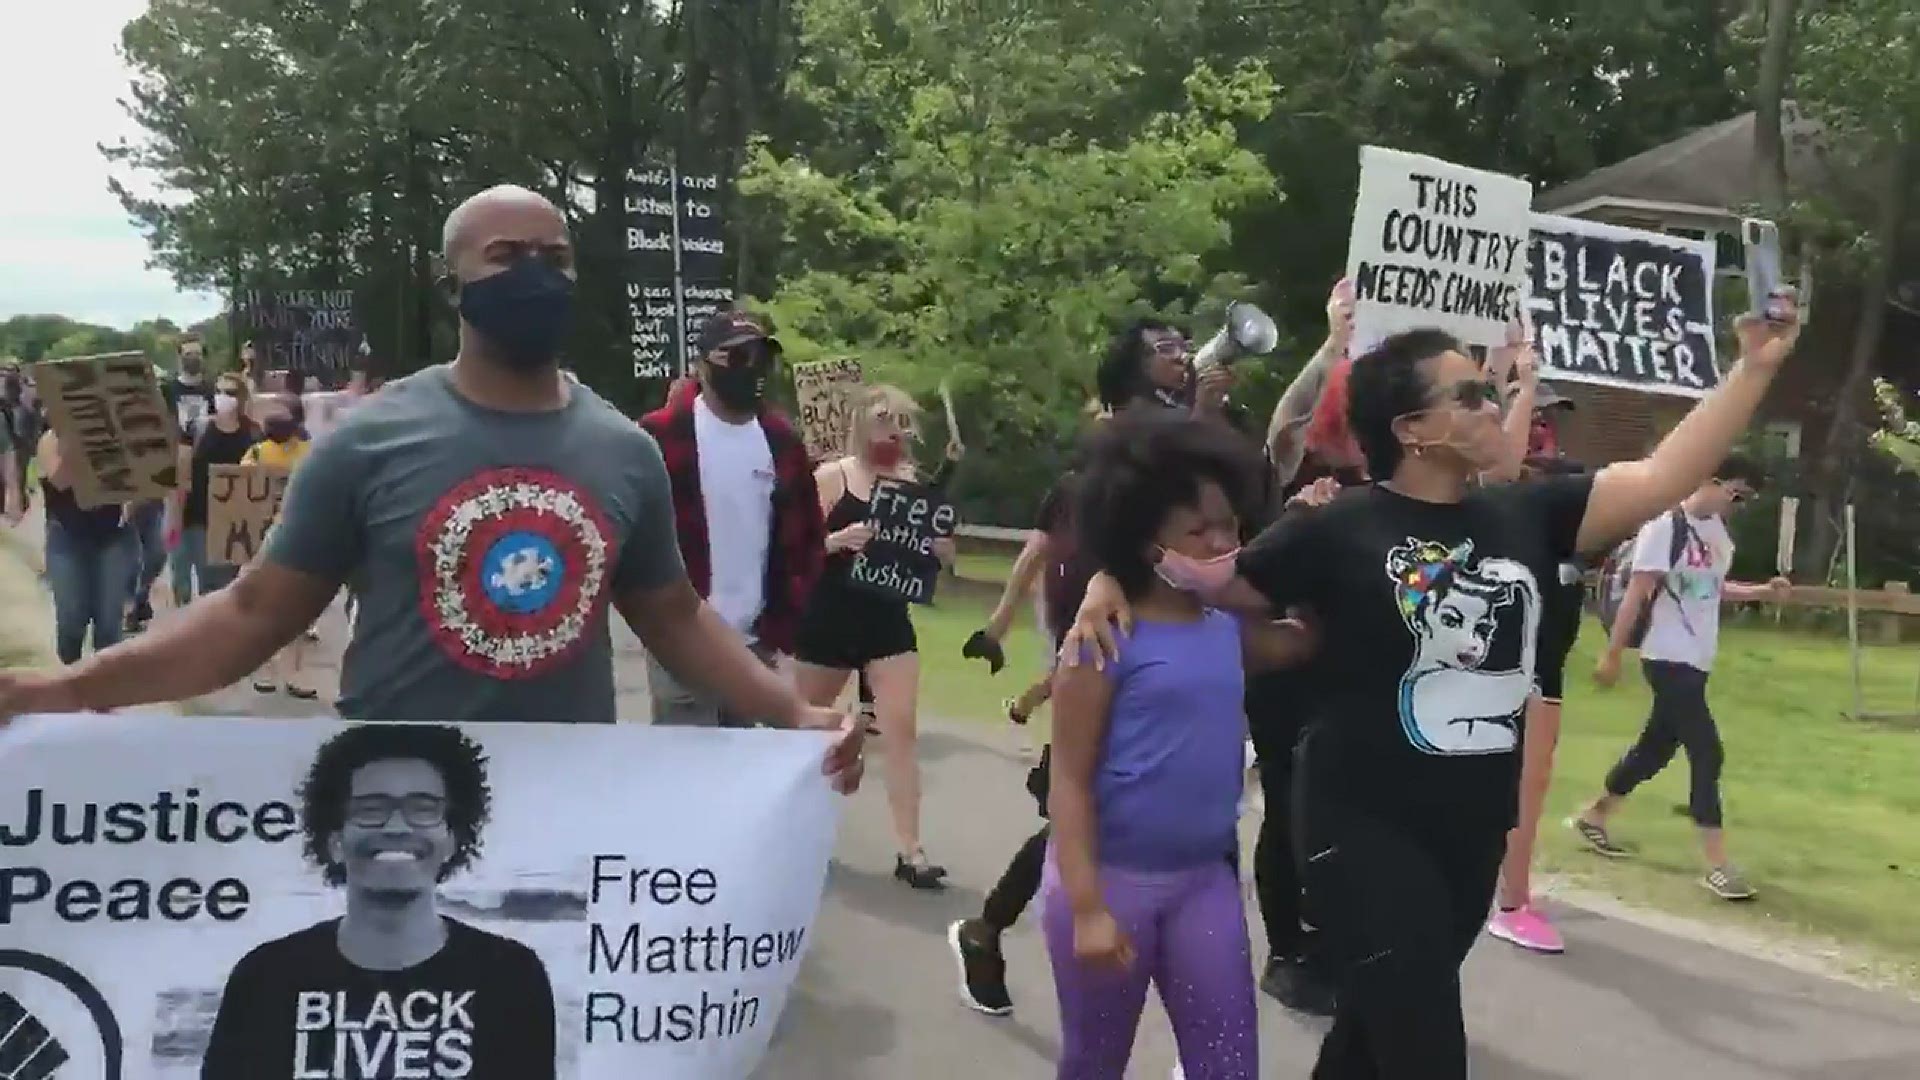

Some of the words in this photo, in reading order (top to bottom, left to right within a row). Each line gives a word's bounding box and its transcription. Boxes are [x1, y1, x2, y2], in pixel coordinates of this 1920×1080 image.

[682, 175, 717, 190] and
[685, 199, 711, 218] to
[1409, 173, 1477, 217] THIS
[1382, 209, 1523, 275] COUNTRY
[1357, 261, 1439, 308] NEEDS
[1544, 241, 1683, 304] BLACK
[1561, 290, 1685, 342] LIVES
[1541, 323, 1704, 388] MATTER
[870, 482, 954, 534] Free
[851, 554, 923, 597] Rushin
[0, 788, 299, 846] Justice
[0, 866, 250, 924] Peace
[591, 854, 716, 905] Free
[588, 922, 805, 974] Matthew
[296, 990, 476, 1030] BLACK
[585, 988, 759, 1043] Rushin
[293, 1029, 473, 1080] LIVES
